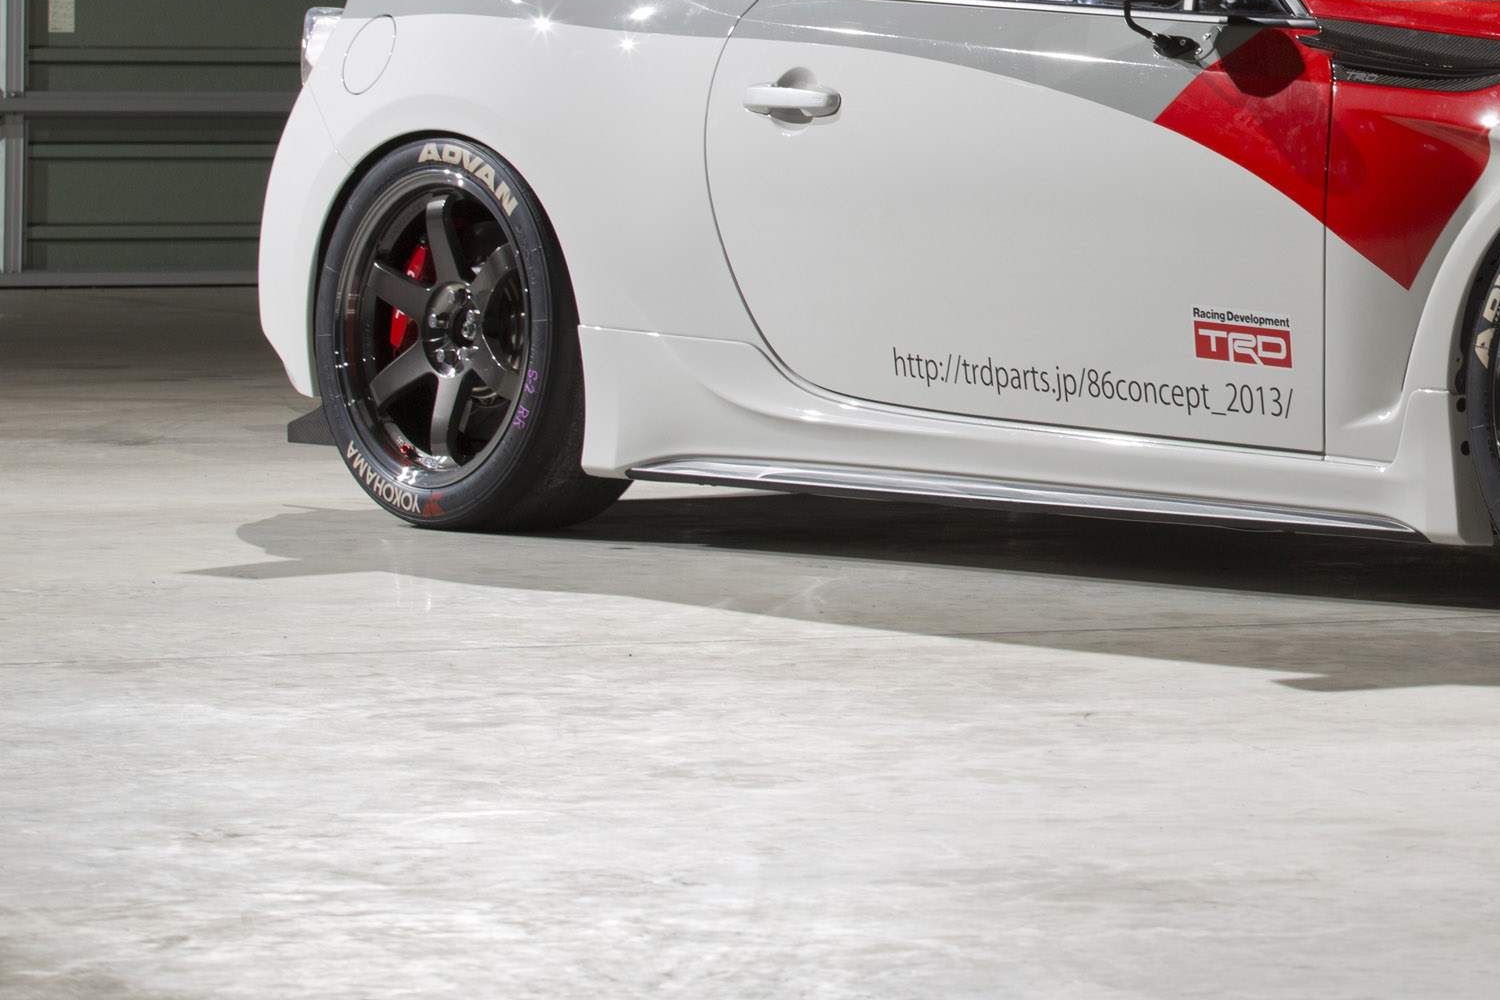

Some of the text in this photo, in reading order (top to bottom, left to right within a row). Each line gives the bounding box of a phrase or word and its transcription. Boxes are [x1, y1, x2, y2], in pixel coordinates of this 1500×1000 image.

[418, 143, 518, 217] ADVAN
[1193, 307, 1290, 328] Racing Development
[1198, 328, 1287, 366] TRD
[892, 346, 1294, 419] http://trdparts.jp/86concept_2013/
[346, 440, 421, 513] YOKOHAMA
